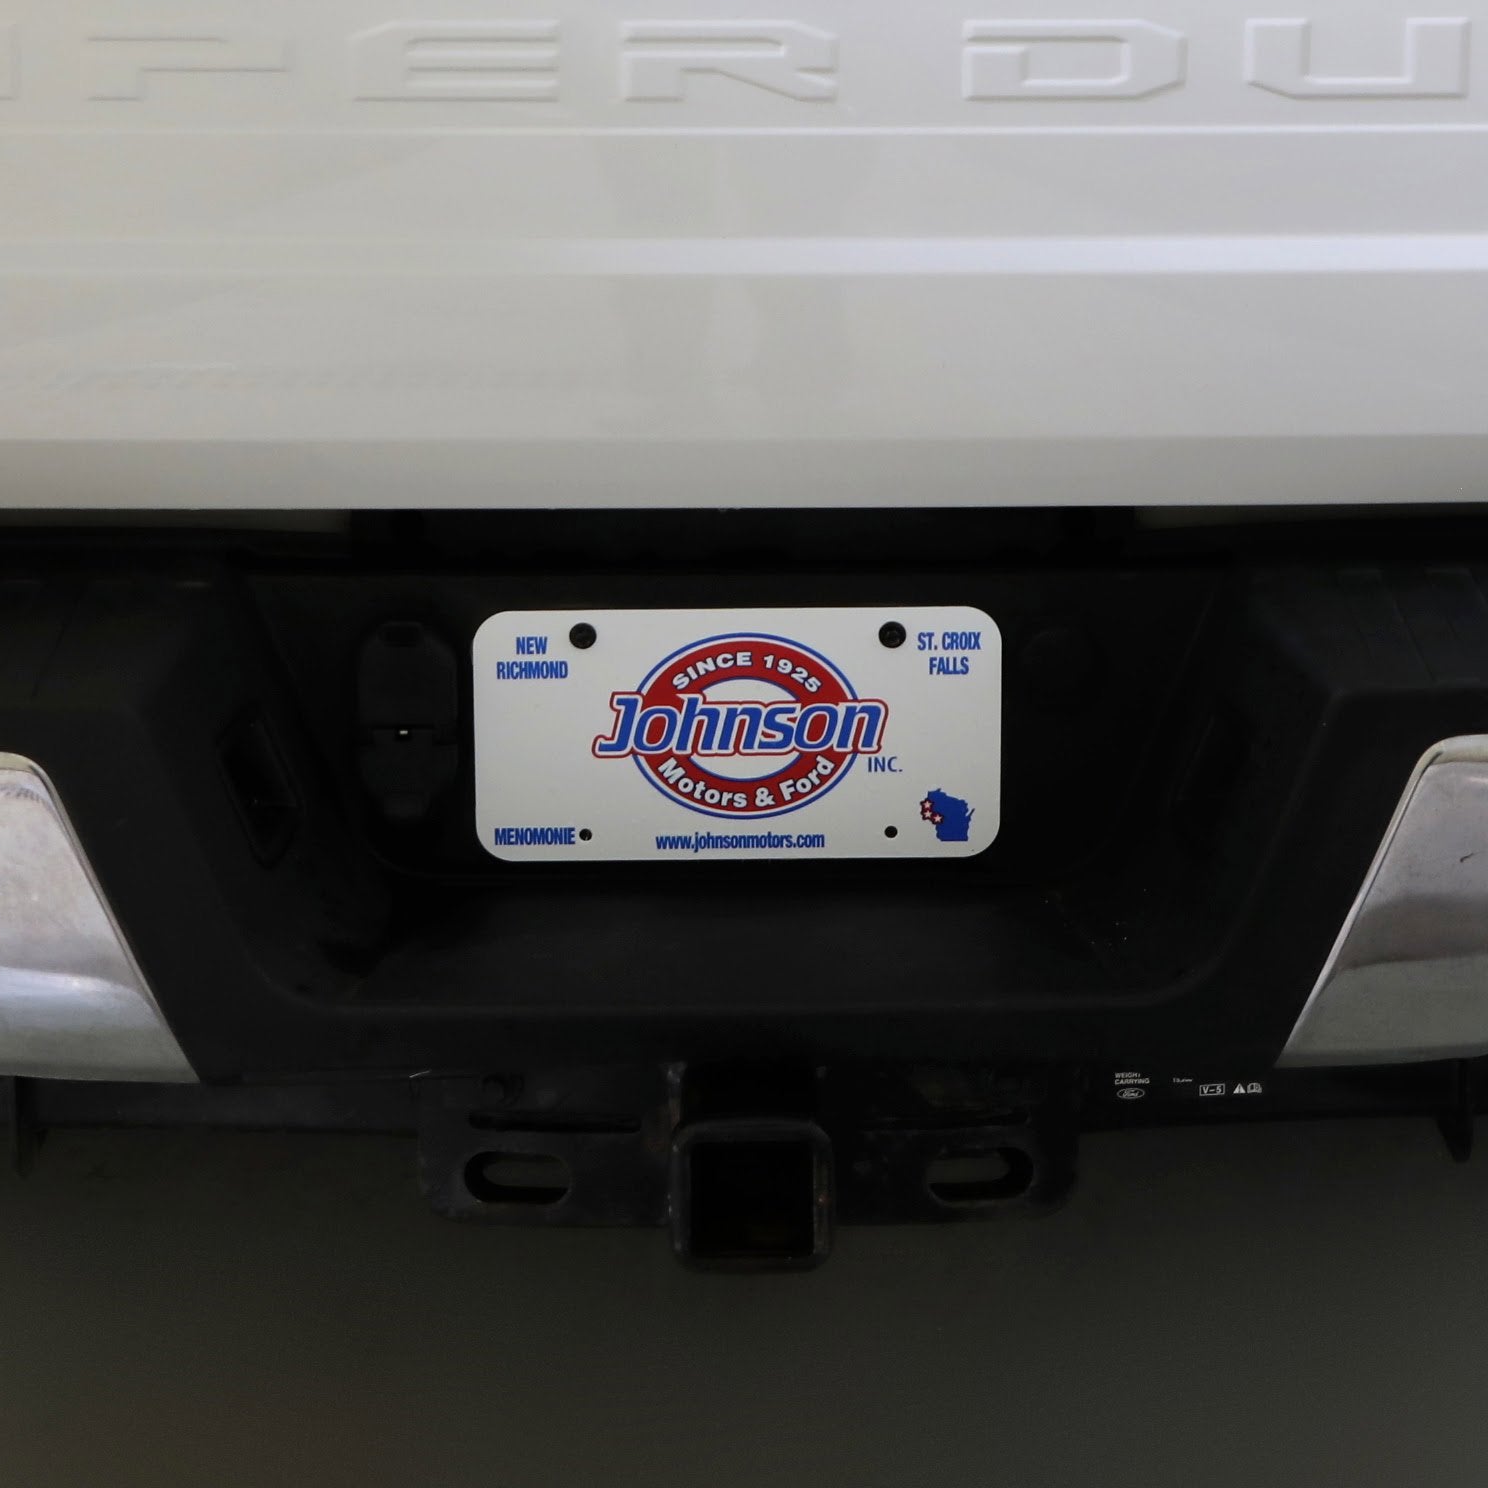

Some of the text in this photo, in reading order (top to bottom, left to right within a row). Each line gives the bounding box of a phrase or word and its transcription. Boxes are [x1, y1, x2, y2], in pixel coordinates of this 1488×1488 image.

[515, 636, 549, 656] NEW
[916, 630, 982, 652] ST. CROIX
[495, 659, 569, 681] RICHMOND
[671, 650, 823, 693] SINCE 1925
[928, 655, 970, 676] FALLS
[595, 694, 886, 756] Johnson
[867, 755, 904, 774] INC.
[656, 755, 836, 810] Motors & Ford
[493, 826, 577, 847] MENOMONIE
[654, 831, 826, 853] www.johnsonmotors.com
[1114, 1077, 1151, 1085] CARRYING
